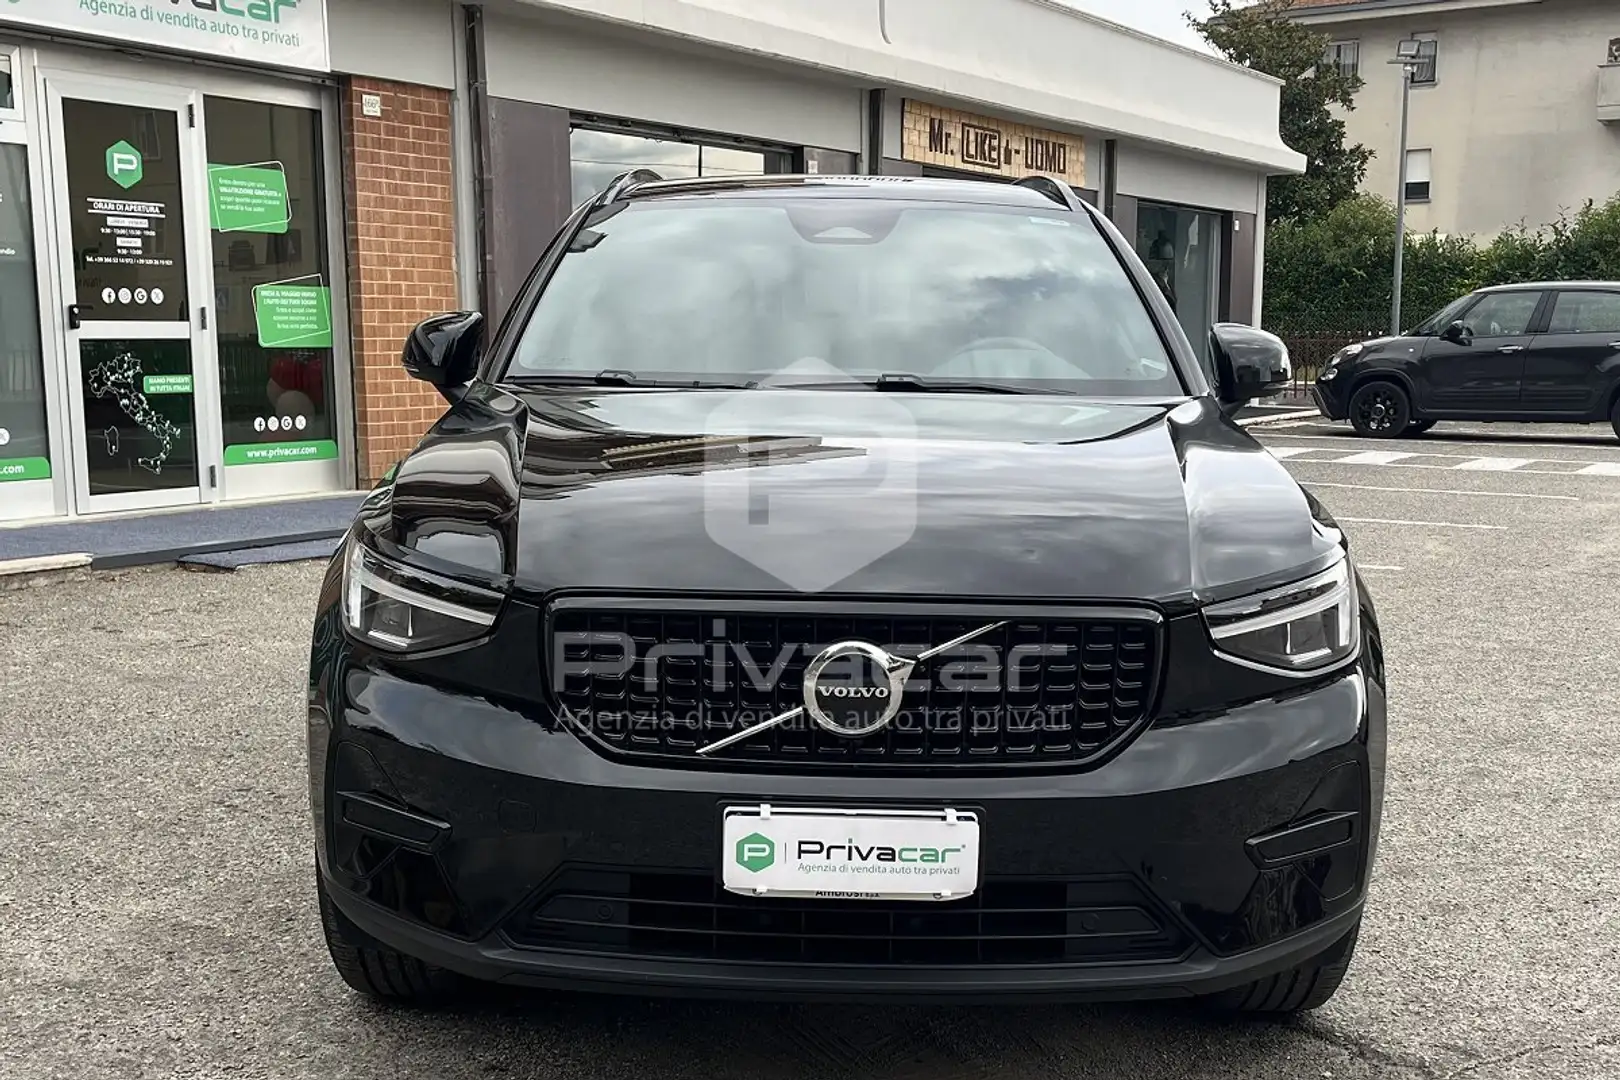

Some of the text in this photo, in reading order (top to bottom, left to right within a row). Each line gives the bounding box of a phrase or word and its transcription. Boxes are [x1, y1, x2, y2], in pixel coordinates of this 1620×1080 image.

[79, 0, 300, 47] Agenzia di vendita auto tra privati
[928, 117, 954, 156] Mr.
[964, 128, 998, 164] LIKE
[1024, 136, 1067, 174] UOMO
[246, 446, 318, 459] www.privacar.com
[816, 685, 889, 698] VOLVO
[797, 838, 961, 863] Privacar
[797, 862, 960, 876] Agenzia di vendita auto tra privati
